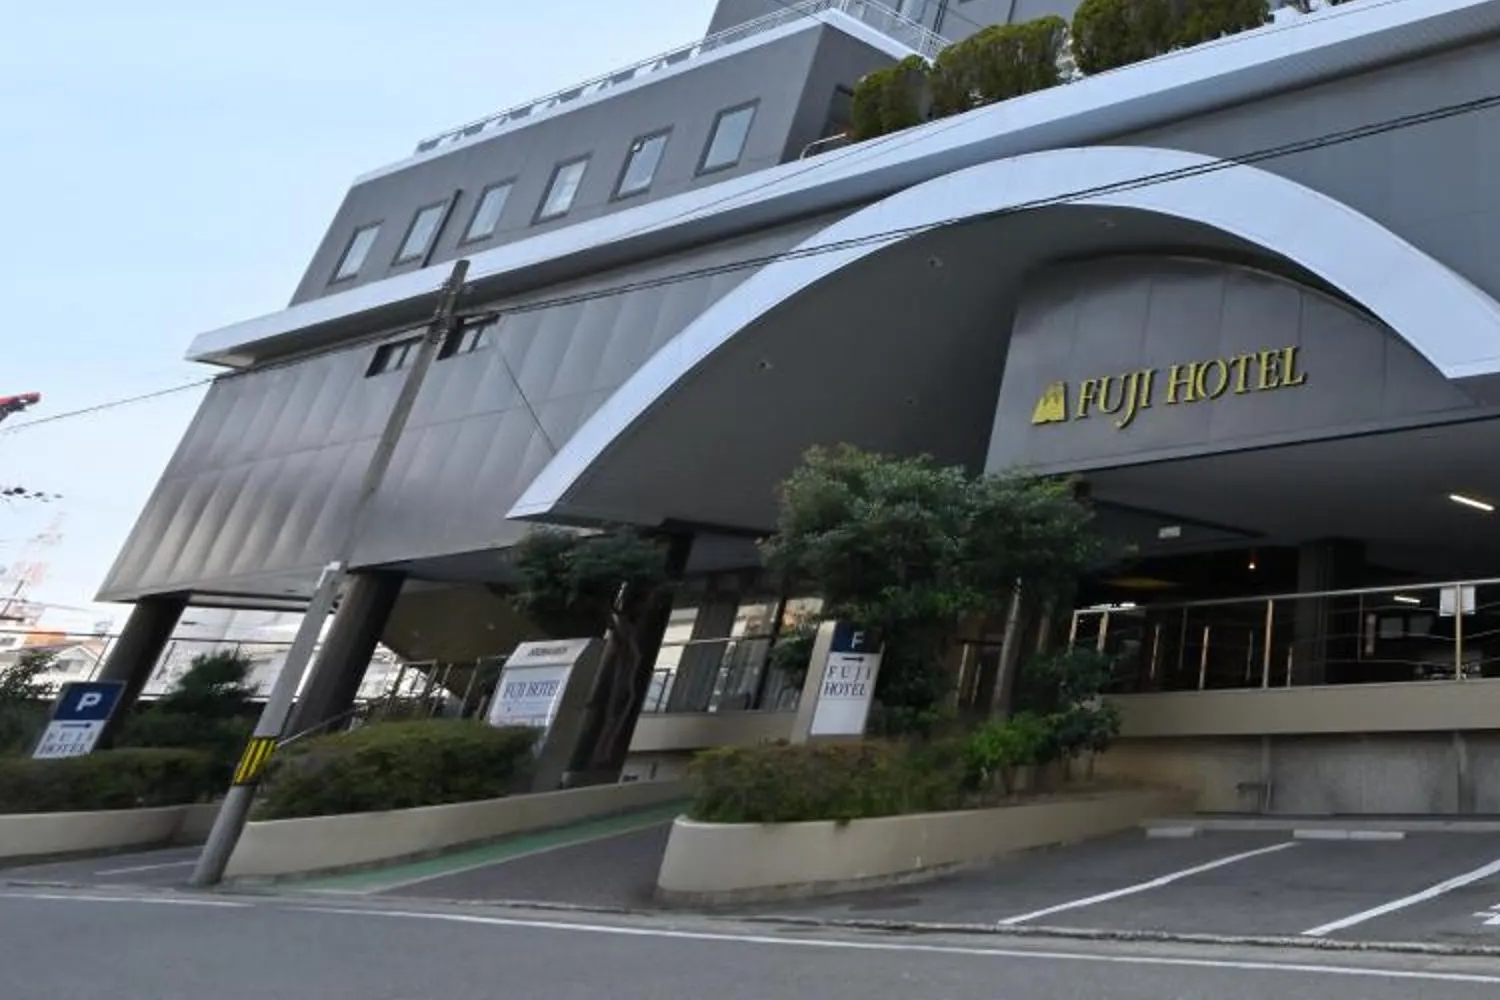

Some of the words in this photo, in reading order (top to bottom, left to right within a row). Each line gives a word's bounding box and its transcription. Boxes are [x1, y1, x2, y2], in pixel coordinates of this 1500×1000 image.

[1075, 369, 1157, 429] FUJI
[1167, 346, 1307, 405] HOTEL
[828, 666, 870, 681] FUJI
[824, 683, 865, 696] HOTEL
[75, 692, 102, 711] P
